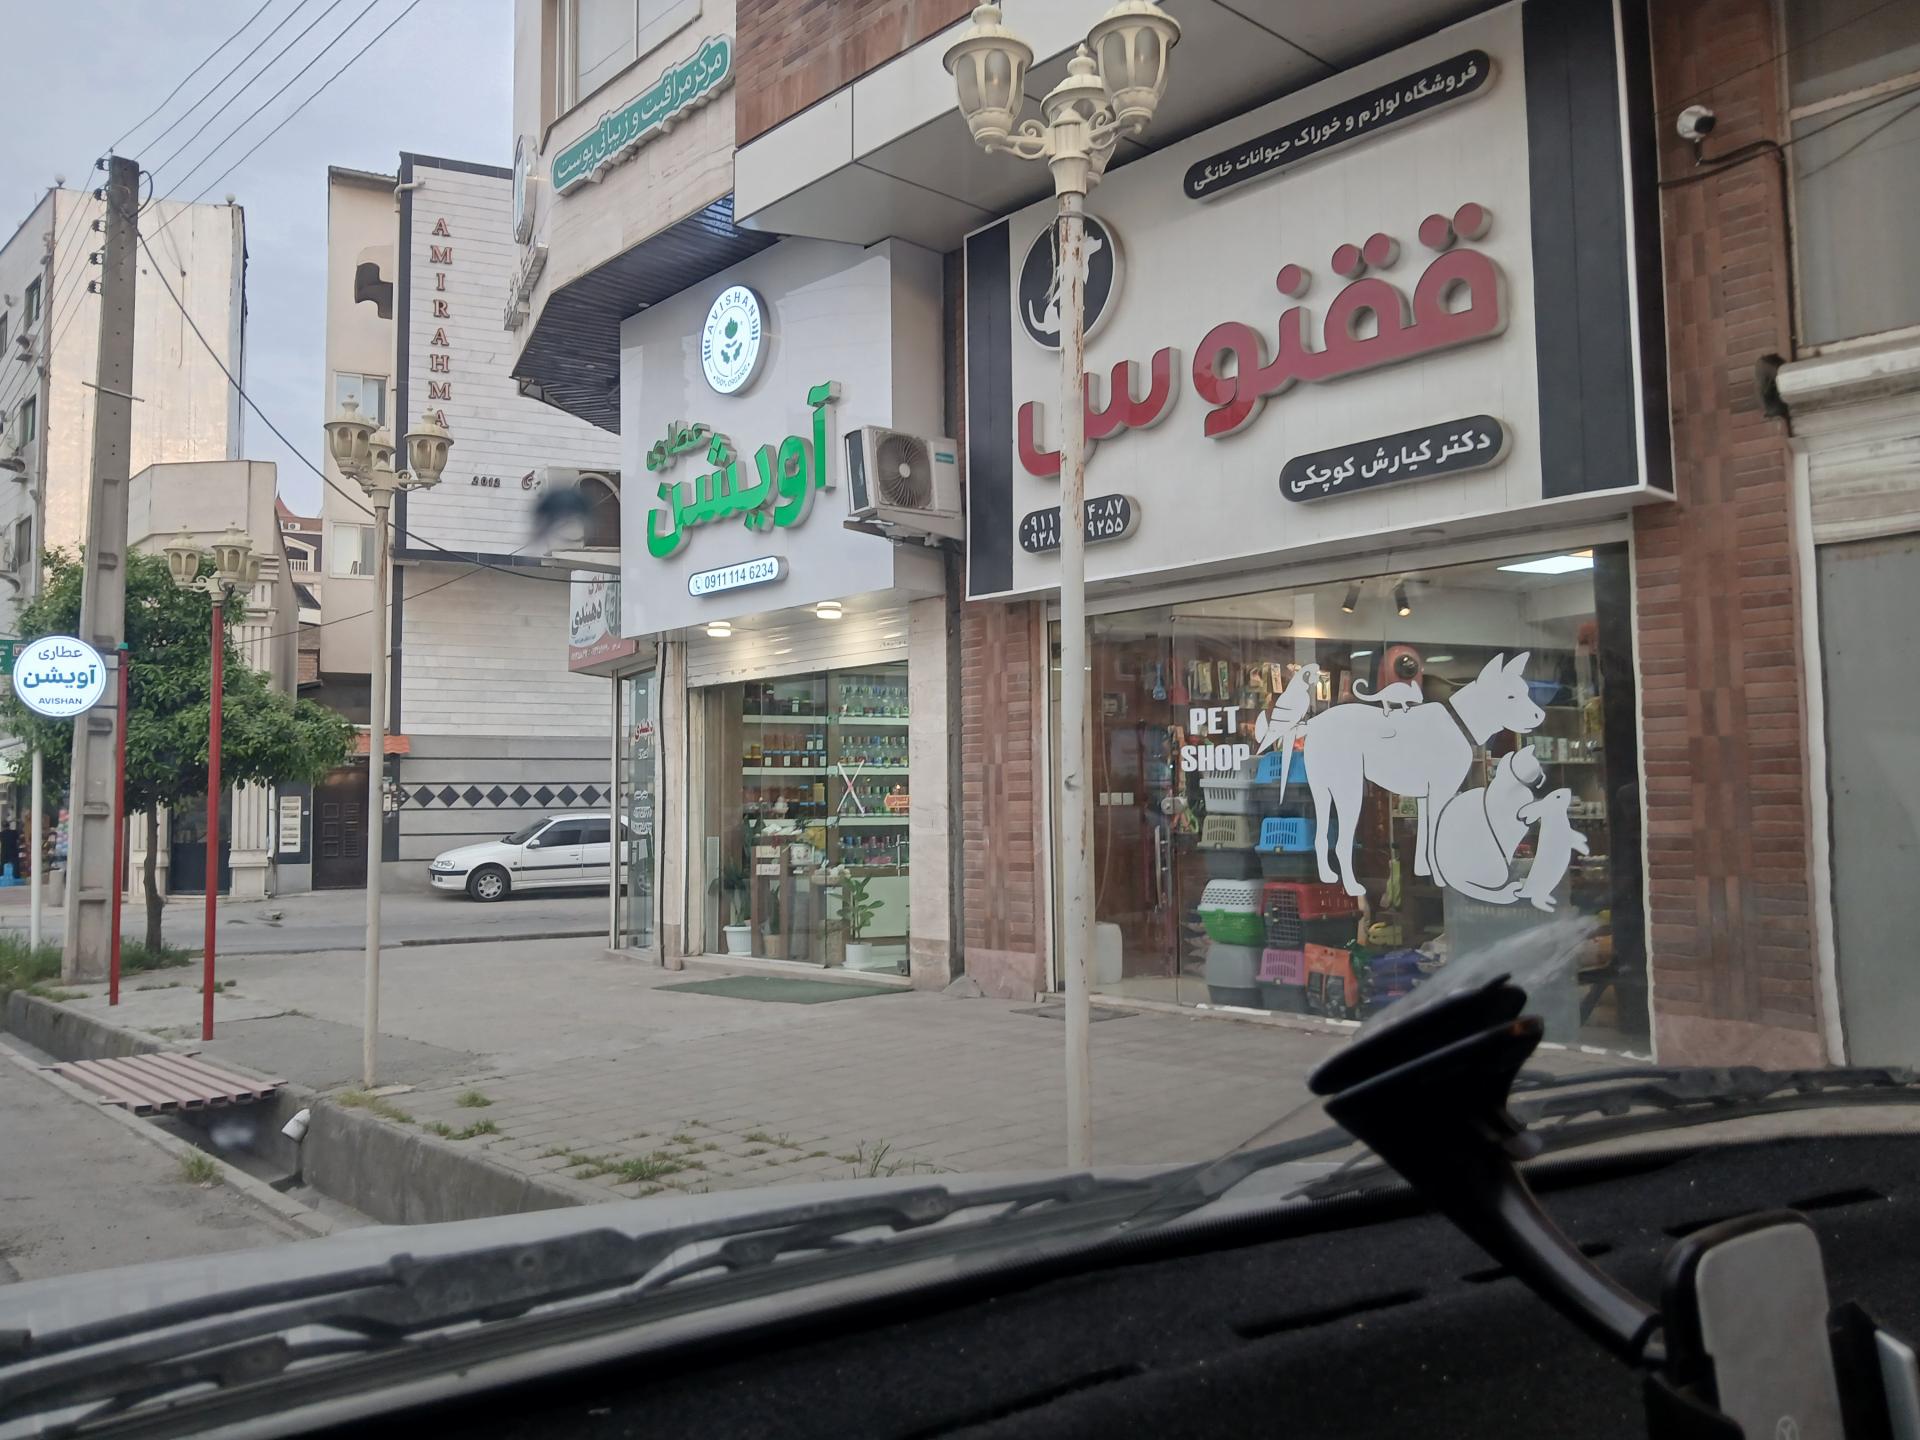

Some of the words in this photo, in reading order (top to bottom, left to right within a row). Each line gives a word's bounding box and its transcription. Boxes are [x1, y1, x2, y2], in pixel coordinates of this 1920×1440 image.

[691, 46, 722, 95] مرکز
[1404, 60, 1478, 104] فروشگاه
[641, 72, 692, 119] مراقبت
[1358, 92, 1400, 127] لوازم
[631, 111, 639, 135] و
[1294, 118, 1341, 148] خوراک
[1345, 114, 1355, 133] و
[557, 143, 594, 178] پوست
[1236, 139, 1291, 170] حیوانات
[1193, 160, 1233, 191] خانگی
[707, 291, 756, 335] AVISHAN
[1018, 202, 1501, 477] ققنوس
[647, 420, 711, 471] عطاری
[1361, 439, 1431, 478] کیارش
[1436, 430, 1491, 464] دکتر
[471, 476, 501, 488] 2012
[647, 381, 838, 559] آویشن
[1290, 456, 1355, 493] کوچکی
[704, 571, 726, 589] 0911
[730, 567, 746, 584] 114
[749, 561, 774, 580] 6234
[38, 645, 83, 660] عطاری
[23, 664, 97, 689] آویشن
[38, 697, 82, 705] AVISHAN
[1189, 705, 1240, 735] PET
[1181, 743, 1250, 772] SHOP
